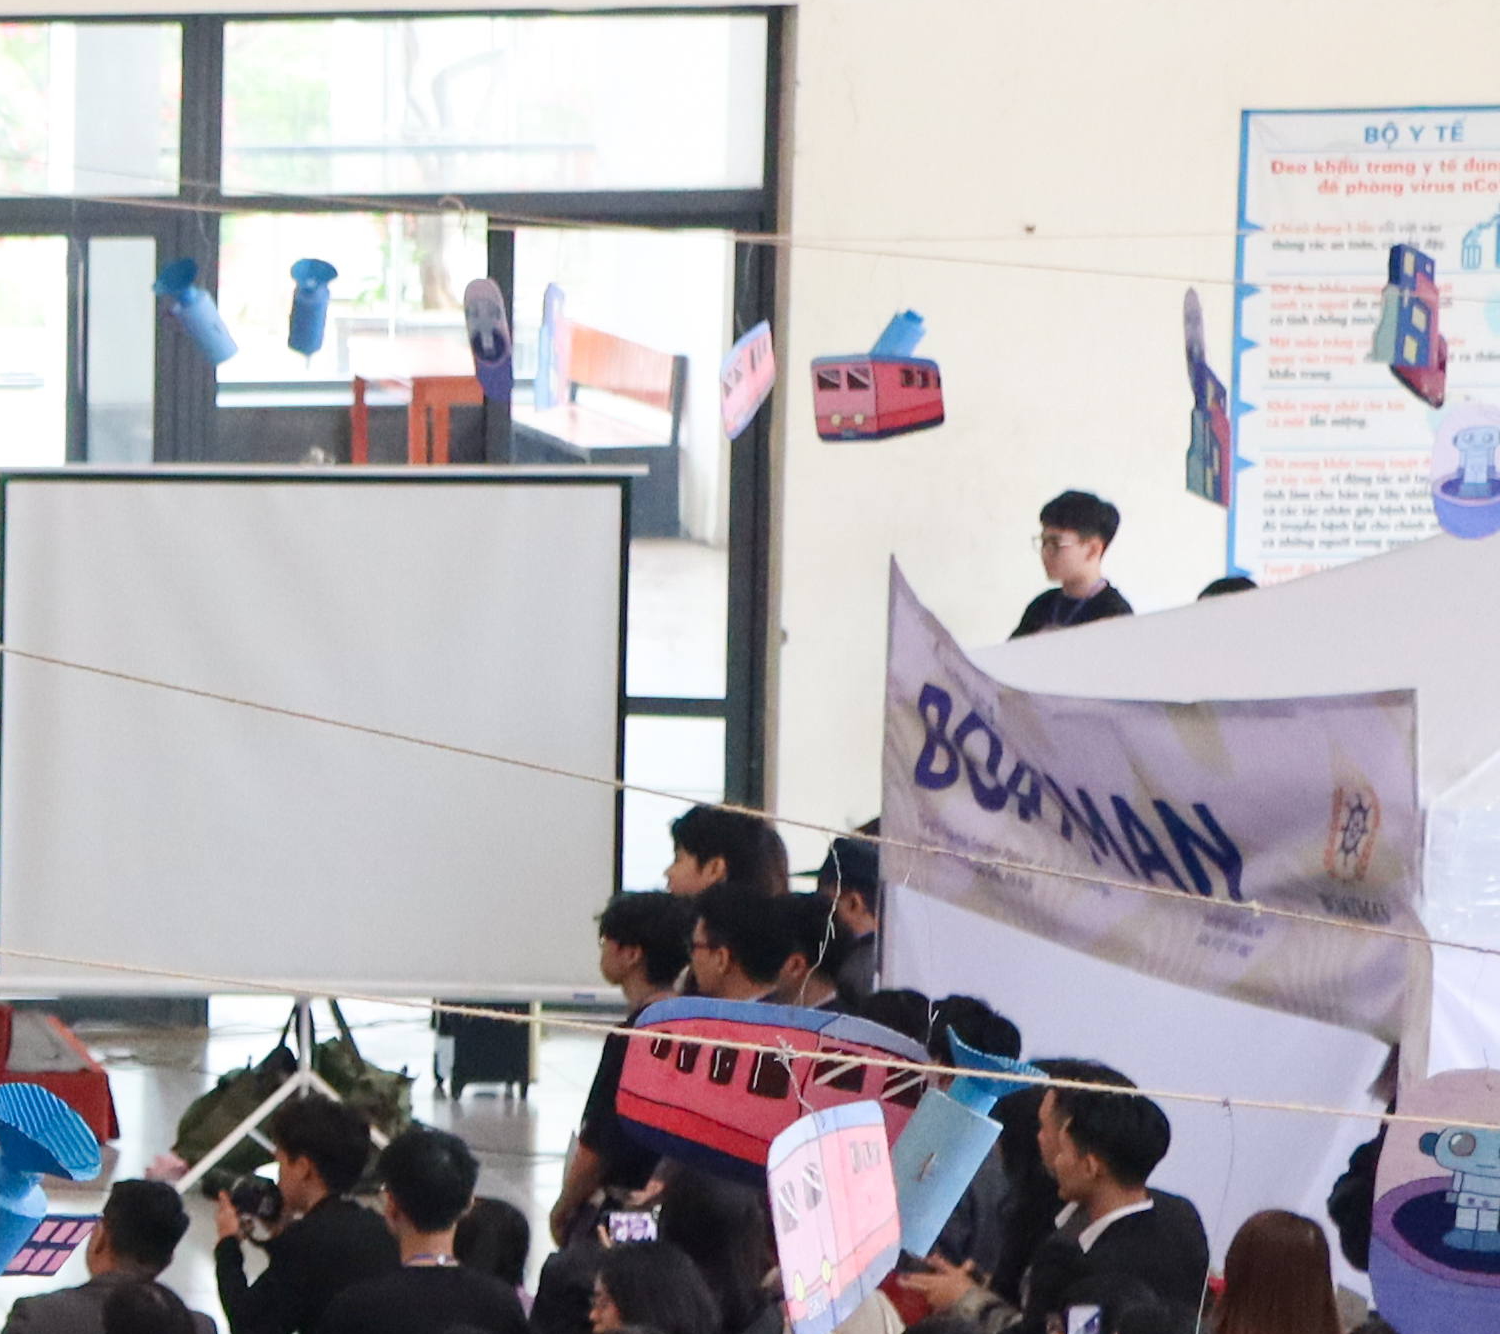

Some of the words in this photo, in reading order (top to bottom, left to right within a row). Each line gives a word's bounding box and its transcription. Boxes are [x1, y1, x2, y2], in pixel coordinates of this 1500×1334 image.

[1364, 122, 1399, 150] BỘ
[1409, 125, 1425, 142] Y
[1435, 118, 1465, 142] TẾ
[1367, 160, 1417, 176] trang
[1411, 181, 1456, 194] virus
[1462, 178, 1500, 194] nCo
